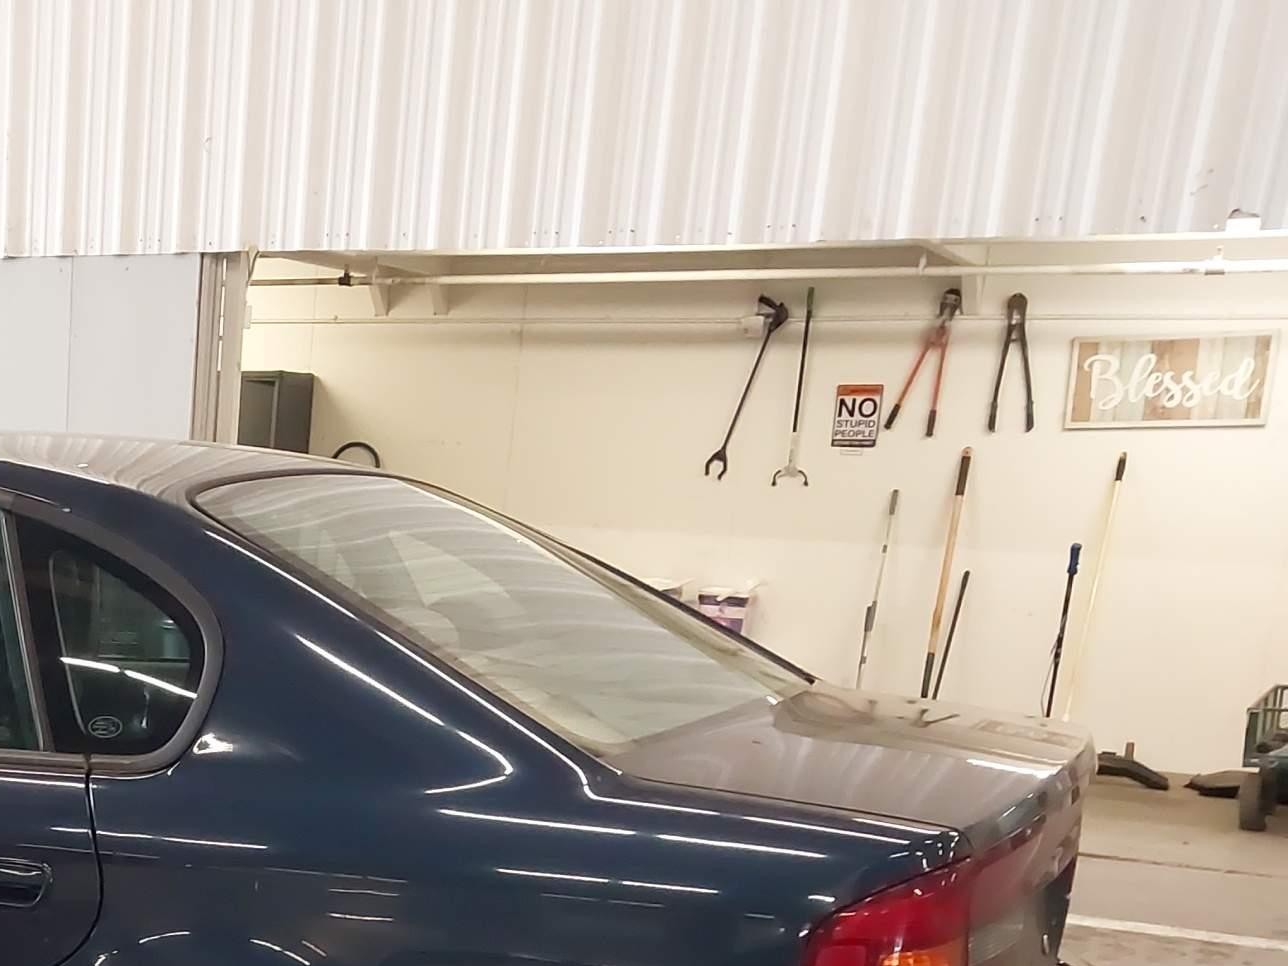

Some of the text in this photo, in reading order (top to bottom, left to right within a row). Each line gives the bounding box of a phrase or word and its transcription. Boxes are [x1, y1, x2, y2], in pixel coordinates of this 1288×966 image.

[1083, 353, 1260, 410] Blessed
[837, 397, 878, 418] NO
[836, 419, 876, 429] STUPID
[834, 429, 875, 438] PEOPLE
